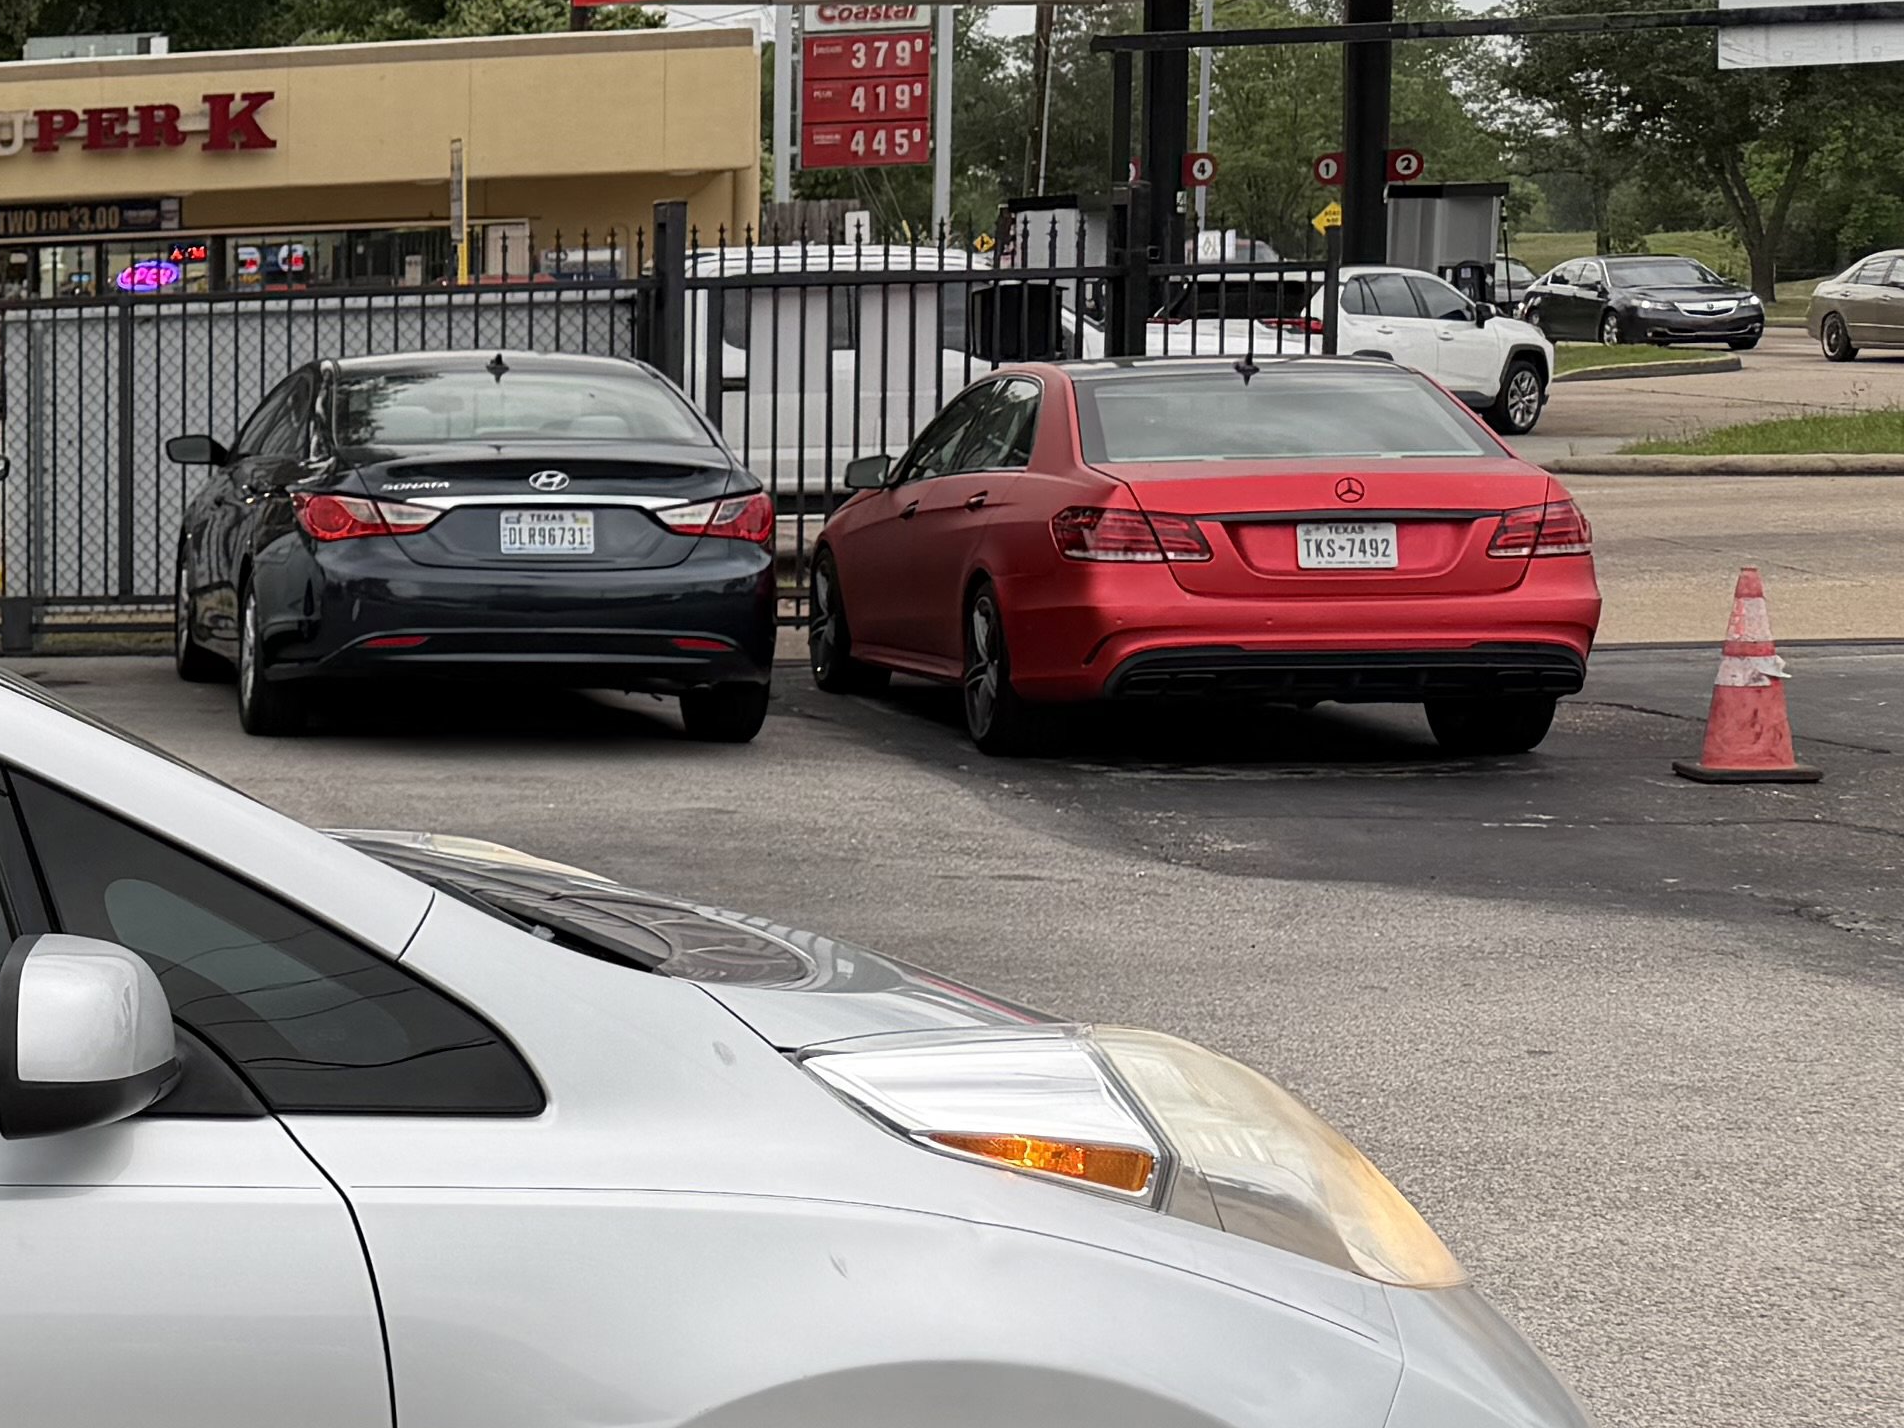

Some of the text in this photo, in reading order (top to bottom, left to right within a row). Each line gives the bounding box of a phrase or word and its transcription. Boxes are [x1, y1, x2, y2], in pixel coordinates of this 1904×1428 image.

[817, 4, 917, 23] Coastal
[201, 91, 278, 152] K
[1197, 162, 1206, 176] 4
[1401, 157, 1412, 171] 2
[42, 210, 70, 230] FOR
[70, 206, 120, 231] $3.00
[380, 481, 450, 491] SONATA
[529, 513, 564, 522] TEXAS
[508, 527, 586, 546] DLR96731
[1328, 525, 1364, 534] TEXAS
